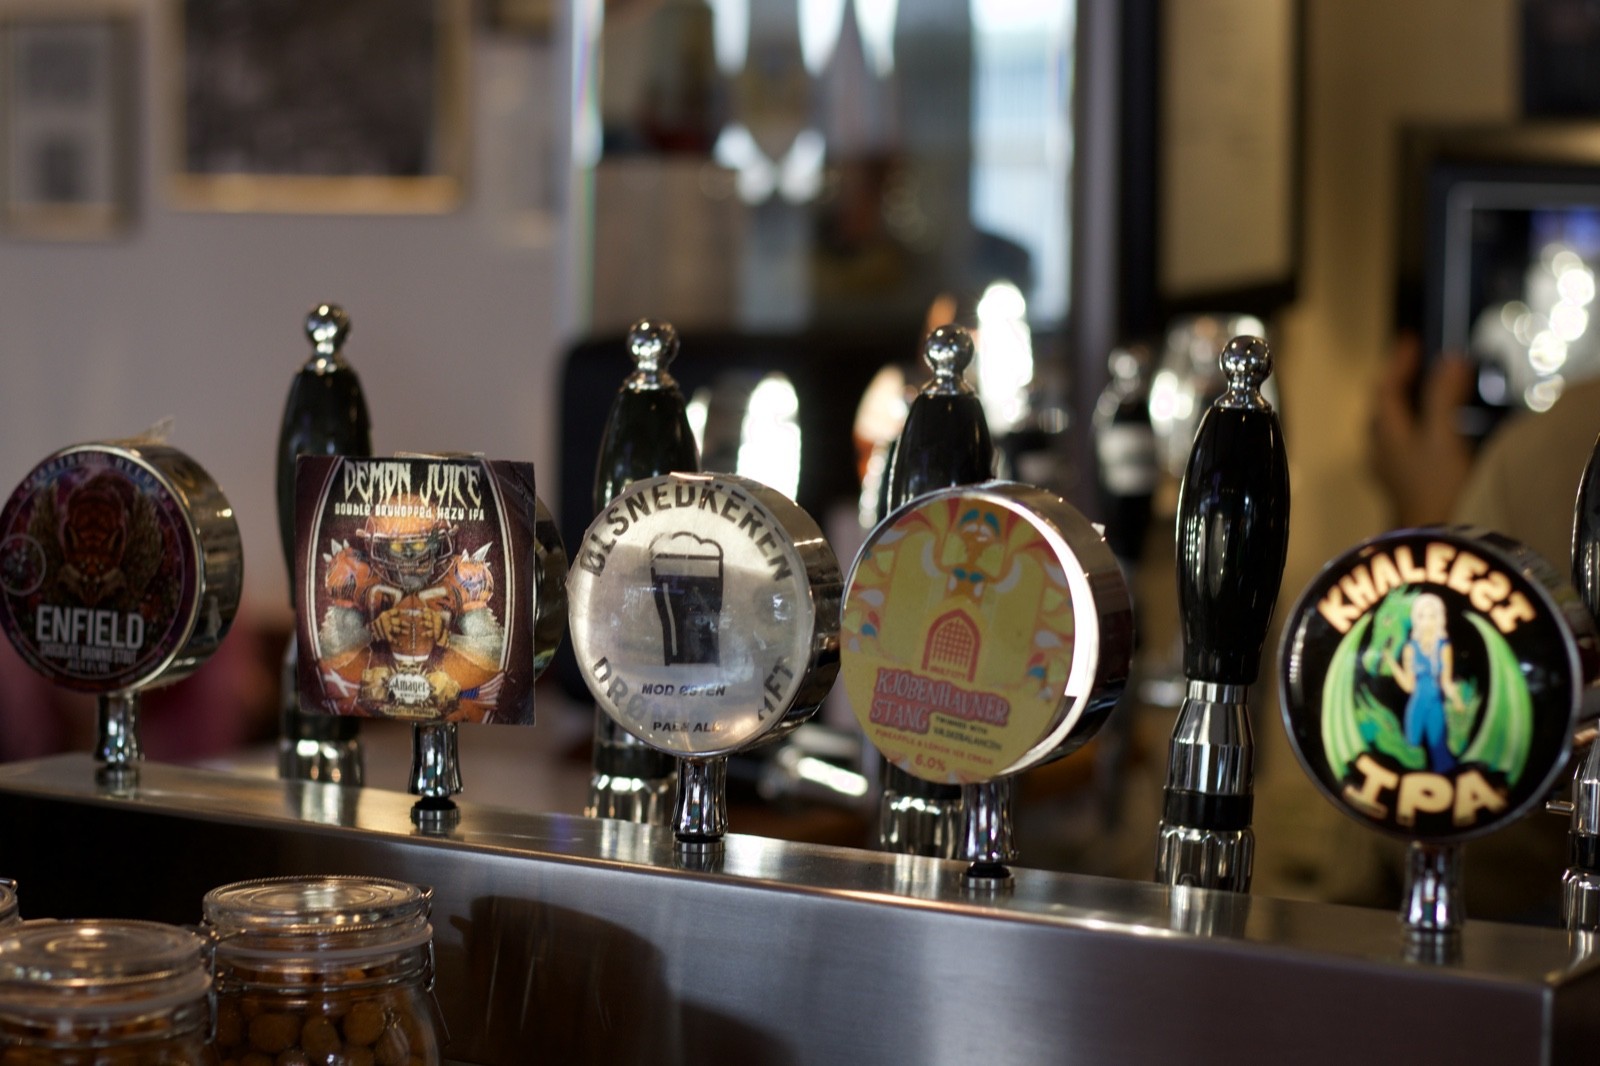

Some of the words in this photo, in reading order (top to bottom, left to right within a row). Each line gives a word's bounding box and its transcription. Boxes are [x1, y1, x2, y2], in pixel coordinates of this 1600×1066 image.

[344, 461, 411, 505] DEMON
[420, 462, 483, 510] JUICE
[468, 509, 485, 521] IPA
[579, 481, 793, 582] ØLSNEDKEREN
[1317, 542, 1536, 634] KHALEESI
[36, 604, 144, 649] ENFIELD
[641, 683, 675, 696] MOD
[872, 699, 928, 730] STANG
[915, 753, 946, 772] 6.0%
[1343, 753, 1508, 827] IPA
